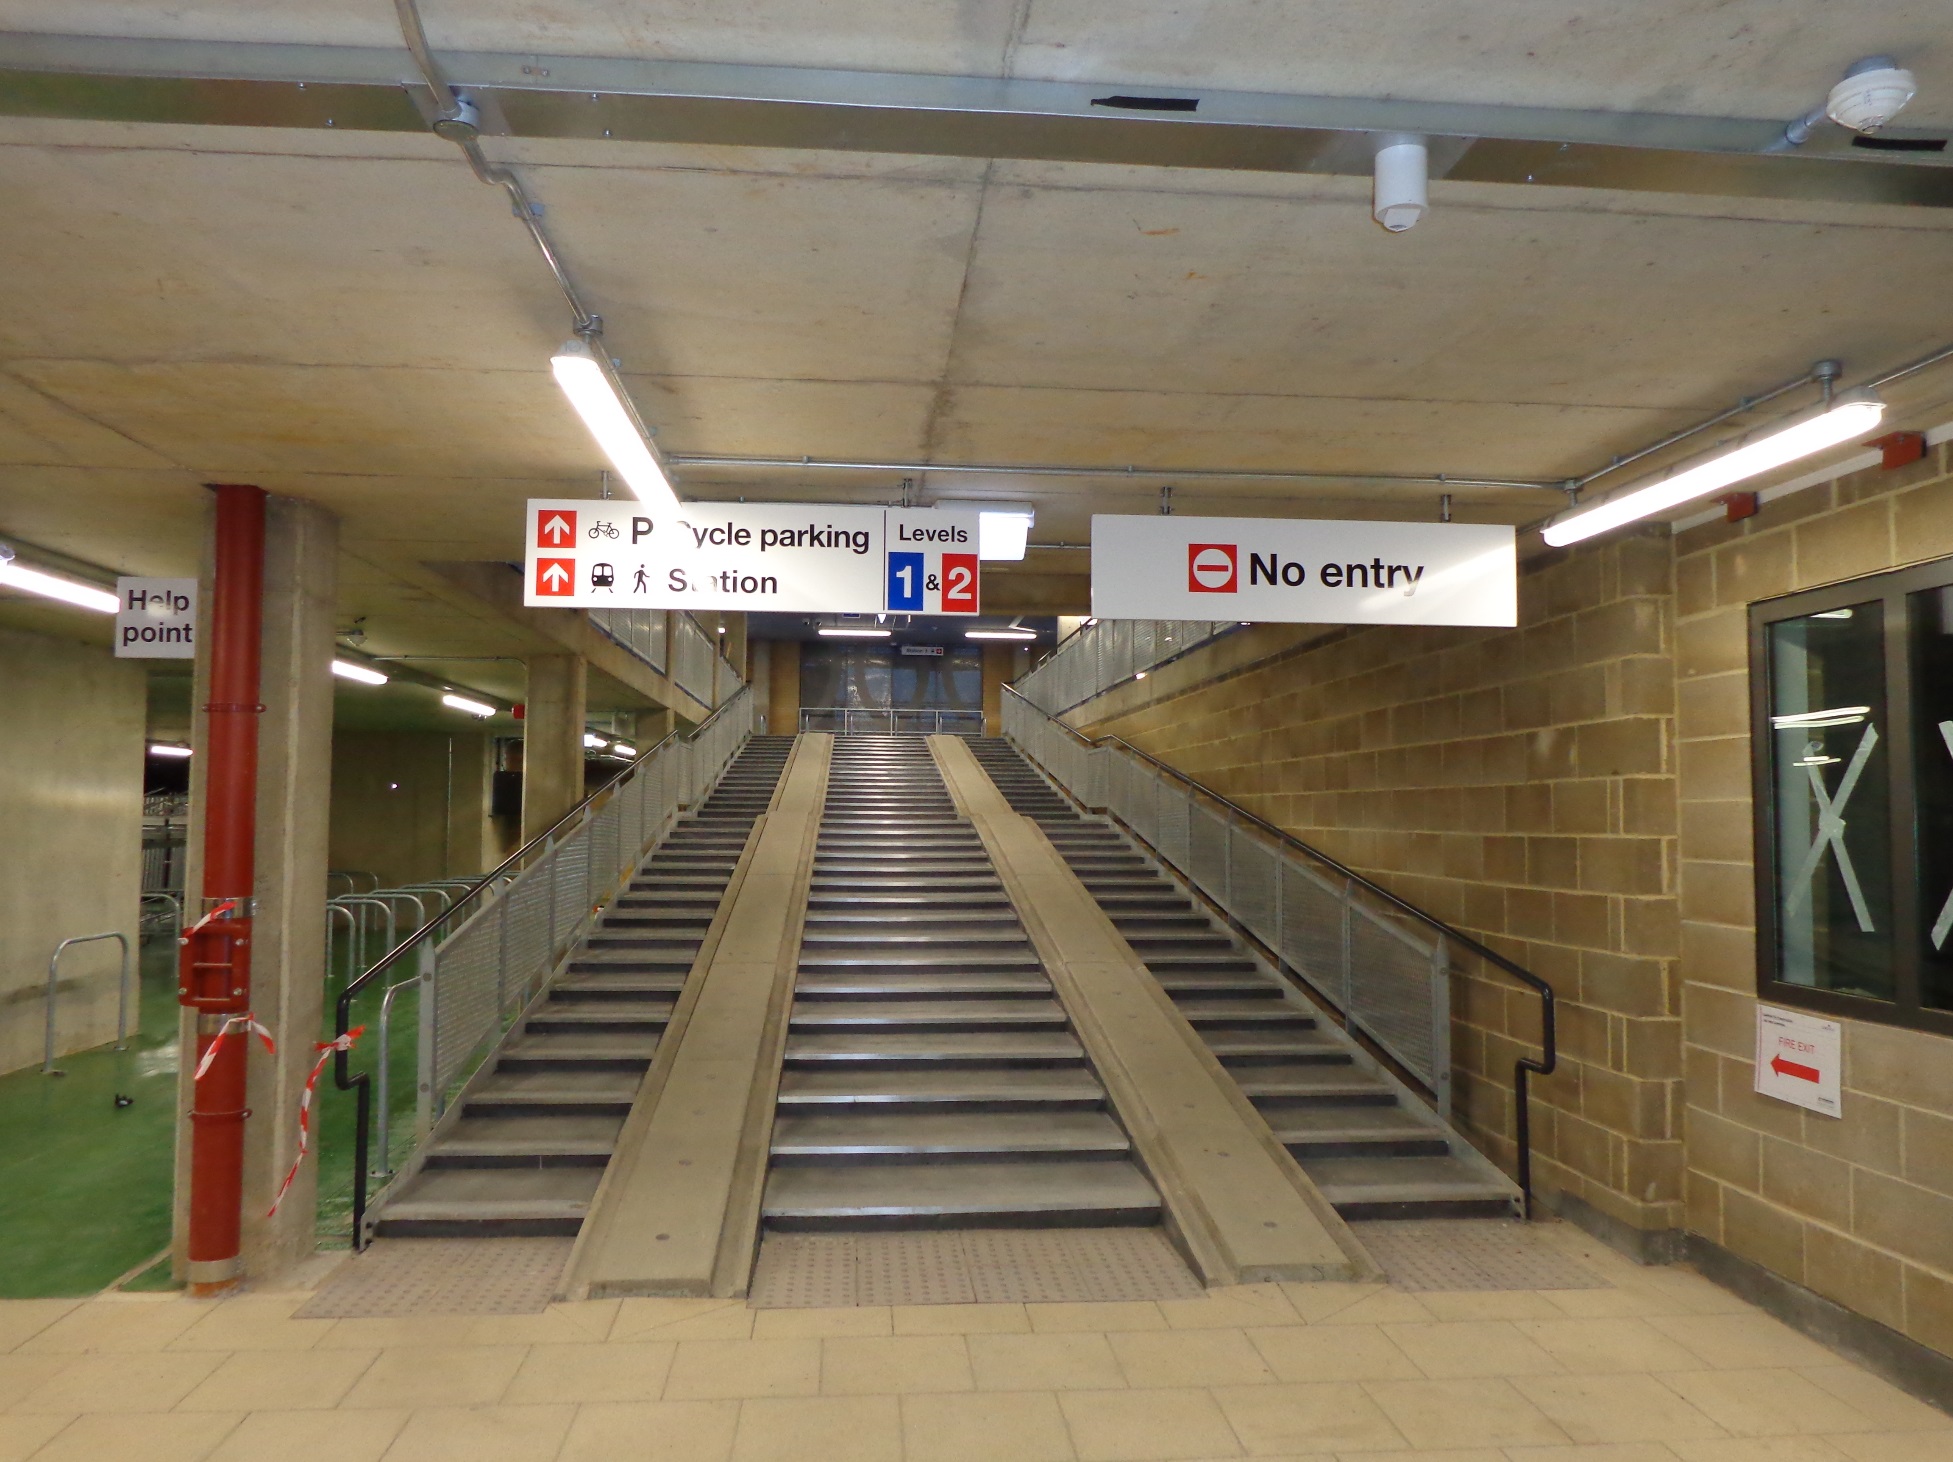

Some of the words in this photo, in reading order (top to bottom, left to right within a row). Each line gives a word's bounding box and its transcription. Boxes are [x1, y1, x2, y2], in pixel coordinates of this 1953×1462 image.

[631, 516, 654, 545] P
[676, 520, 751, 549] ycle
[760, 523, 870, 555] parking
[899, 523, 968, 543] Levels
[667, 568, 778, 594] Stion
[896, 565, 912, 599] 1
[925, 573, 940, 591] &
[947, 566, 972, 600] 2
[1250, 552, 1306, 587] No
[1320, 557, 1425, 597] entry
[123, 621, 193, 647] point
[1778, 1036, 1796, 1050] FIRE
[1797, 1041, 1816, 1055] EXIT
